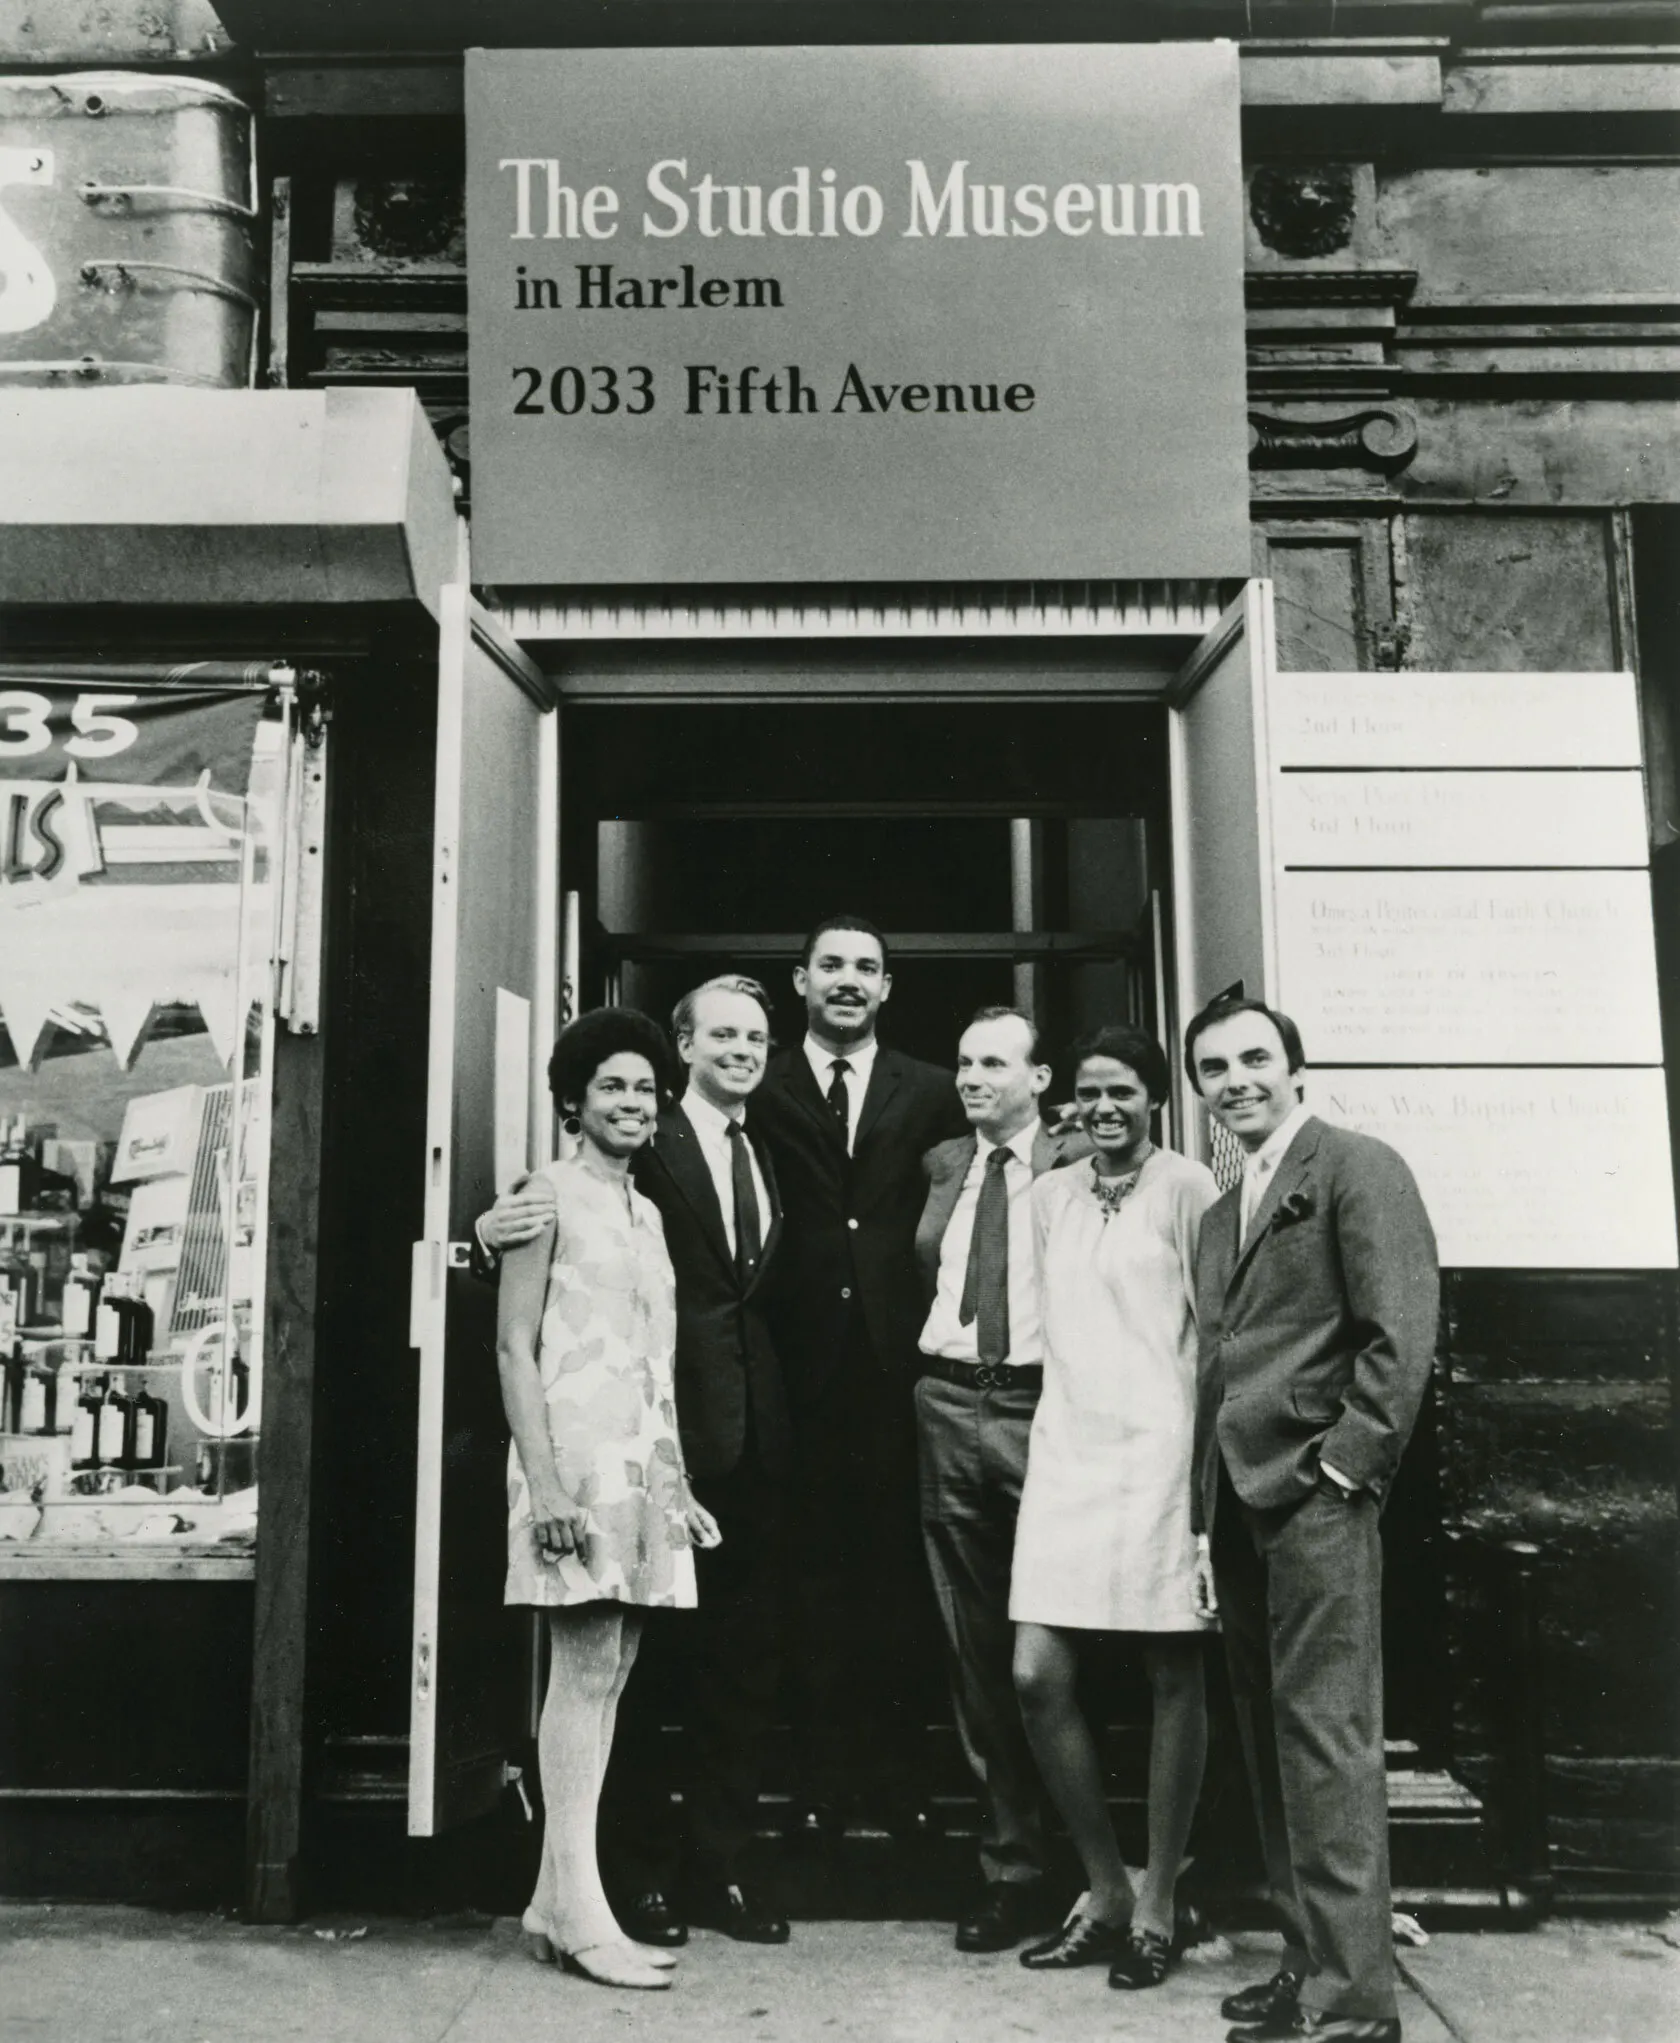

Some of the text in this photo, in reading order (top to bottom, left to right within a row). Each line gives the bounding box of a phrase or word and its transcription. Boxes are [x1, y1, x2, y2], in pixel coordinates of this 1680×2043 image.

[499, 158, 1204, 240] The Studio Museum
[514, 264, 785, 310] in Harlem
[511, 362, 1036, 416] 2033 Fifth Avenue
[1329, 1093, 1379, 1117] New
